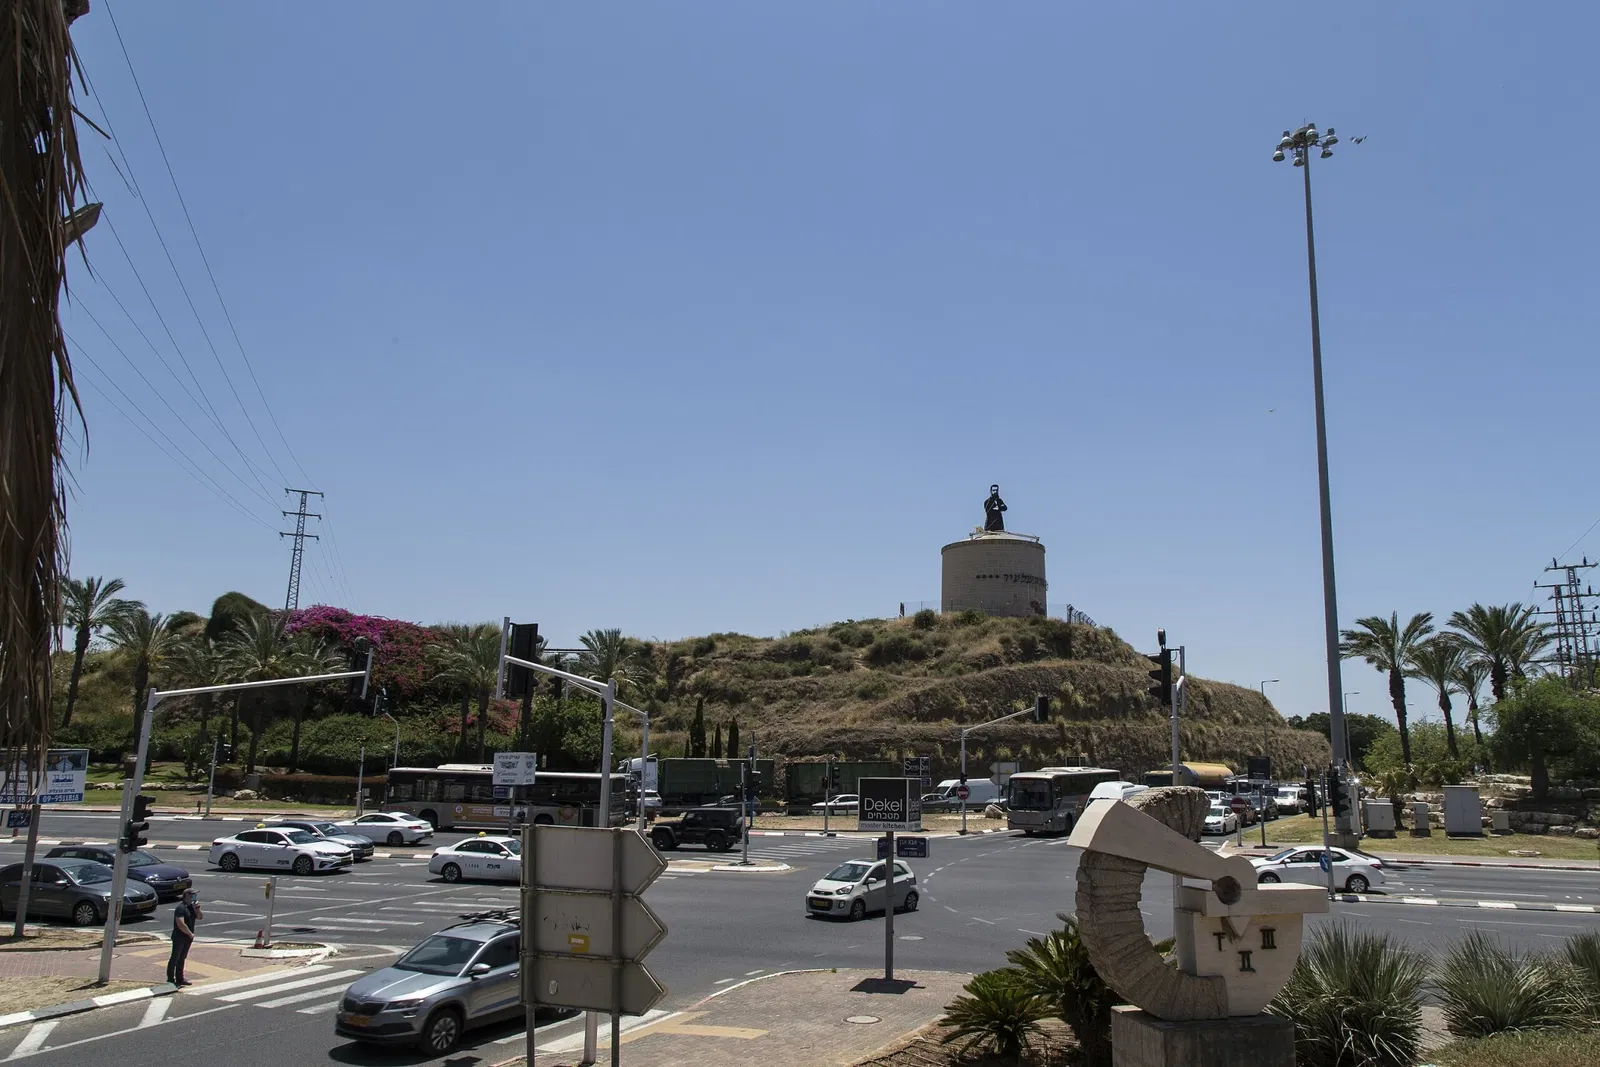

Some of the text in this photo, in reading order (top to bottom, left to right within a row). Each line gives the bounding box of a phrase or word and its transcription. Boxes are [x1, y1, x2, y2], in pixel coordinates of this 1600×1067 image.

[42, 793, 79, 803] 09-9511818
[864, 797, 903, 812] Dekel
[867, 812, 900, 820] מטבחים
